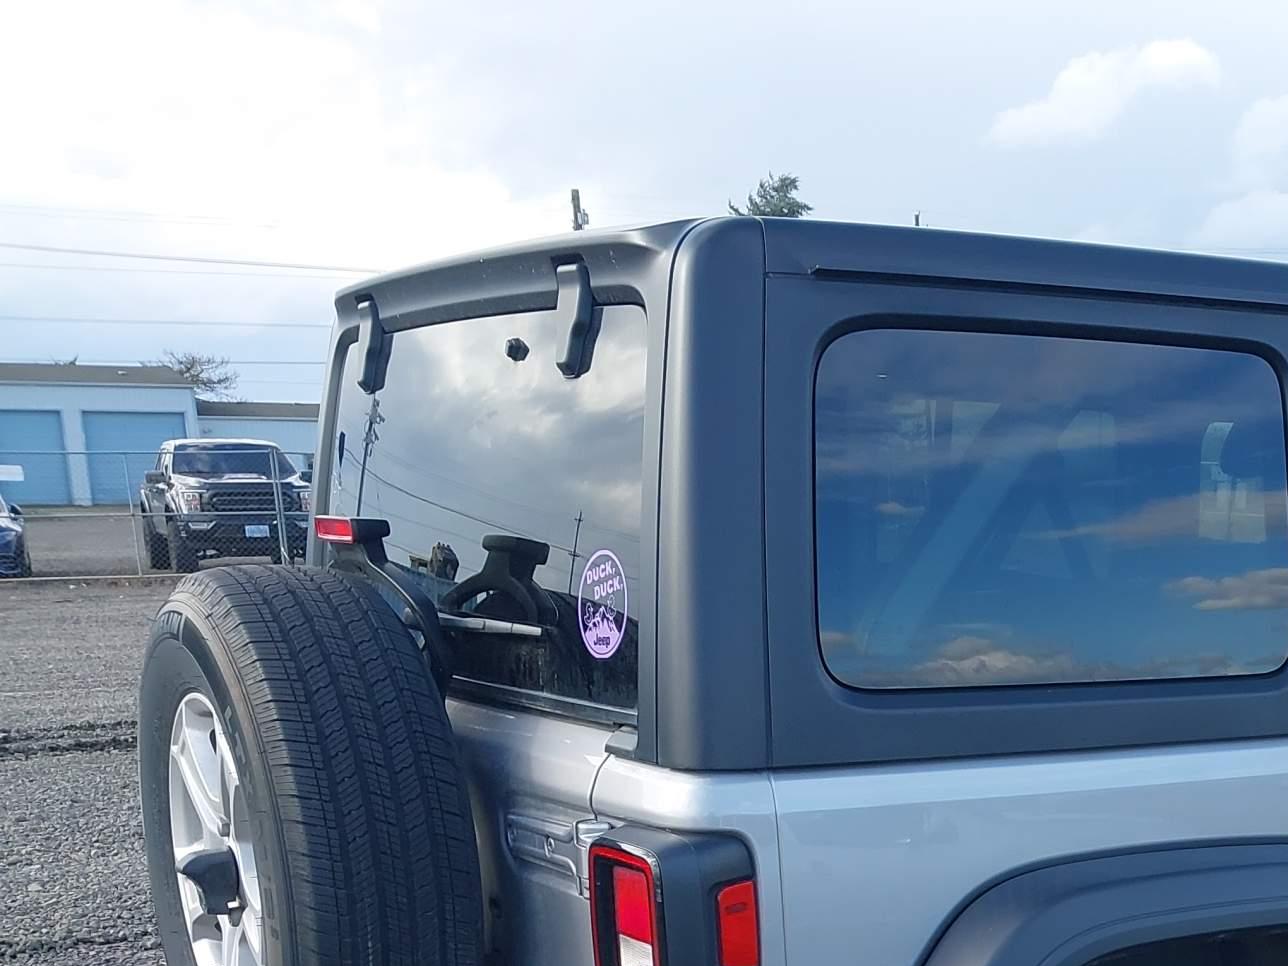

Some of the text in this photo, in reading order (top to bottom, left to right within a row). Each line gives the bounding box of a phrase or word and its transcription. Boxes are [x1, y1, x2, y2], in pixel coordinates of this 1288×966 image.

[586, 560, 616, 585] DUCK,
[594, 575, 623, 600] DUCK,
[593, 633, 610, 648] Jeep
